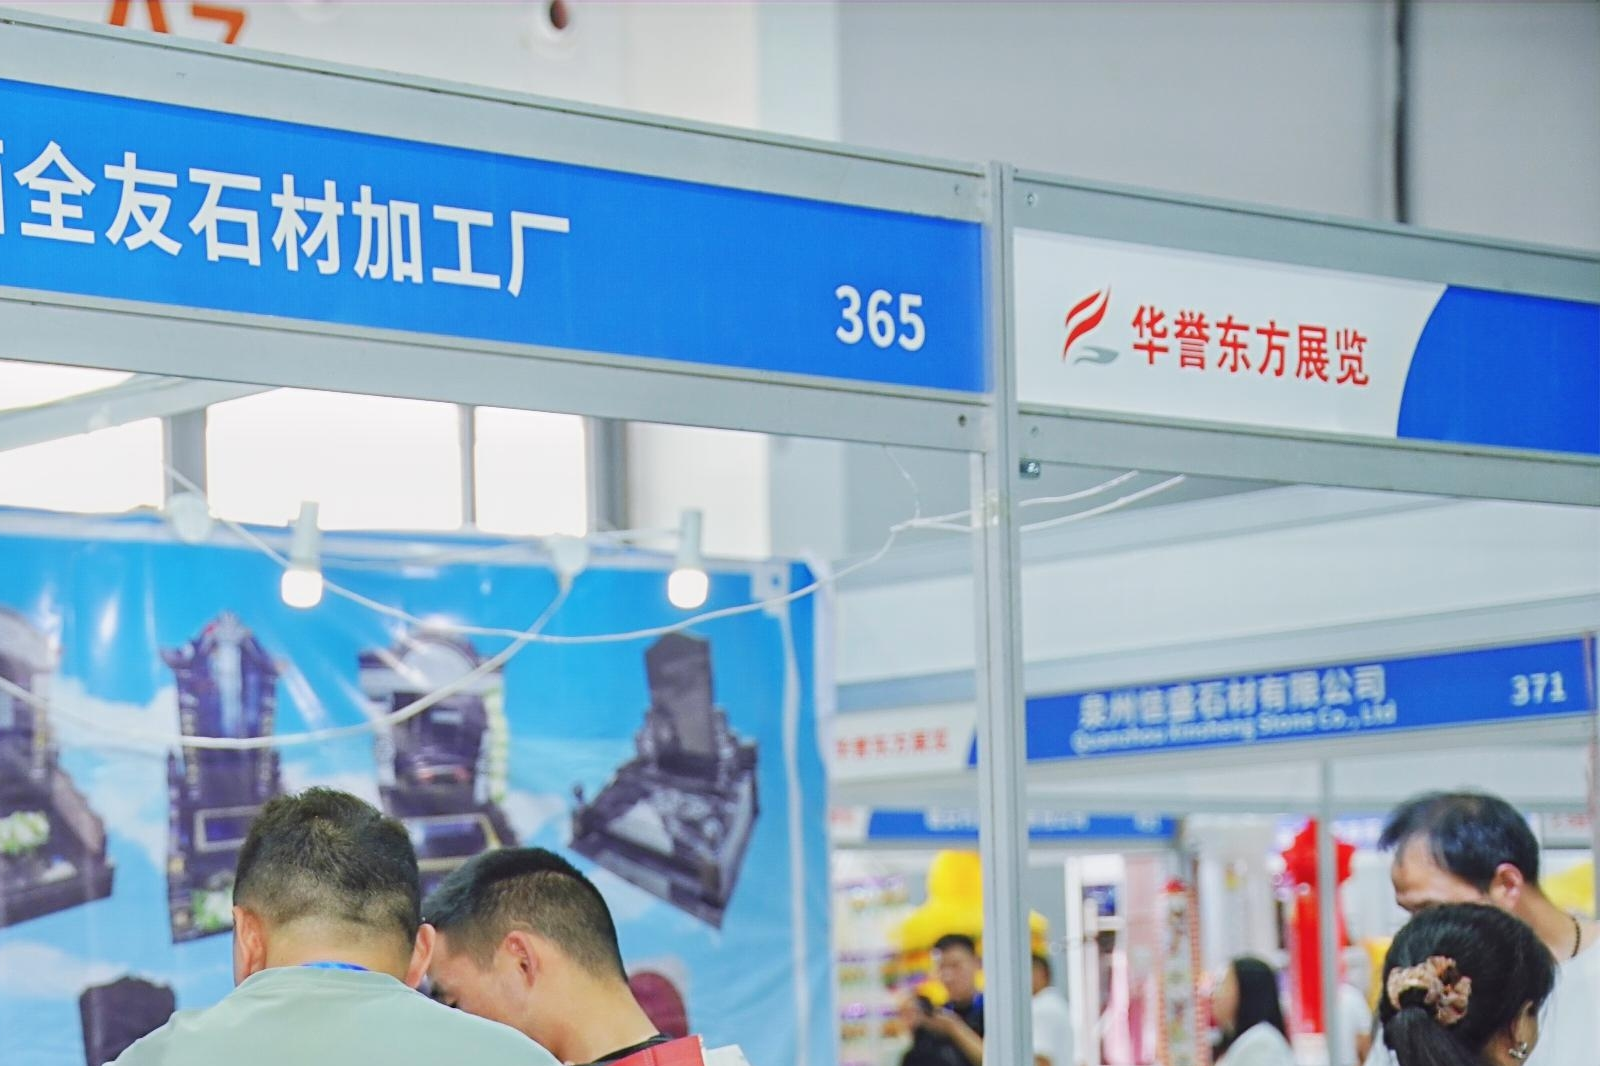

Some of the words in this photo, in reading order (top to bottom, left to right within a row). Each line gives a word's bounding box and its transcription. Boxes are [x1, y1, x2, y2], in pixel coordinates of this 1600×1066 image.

[835, 285, 926, 351] 365
[1130, 304, 1370, 387] 华誉东方展览
[1511, 672, 1566, 706] 371
